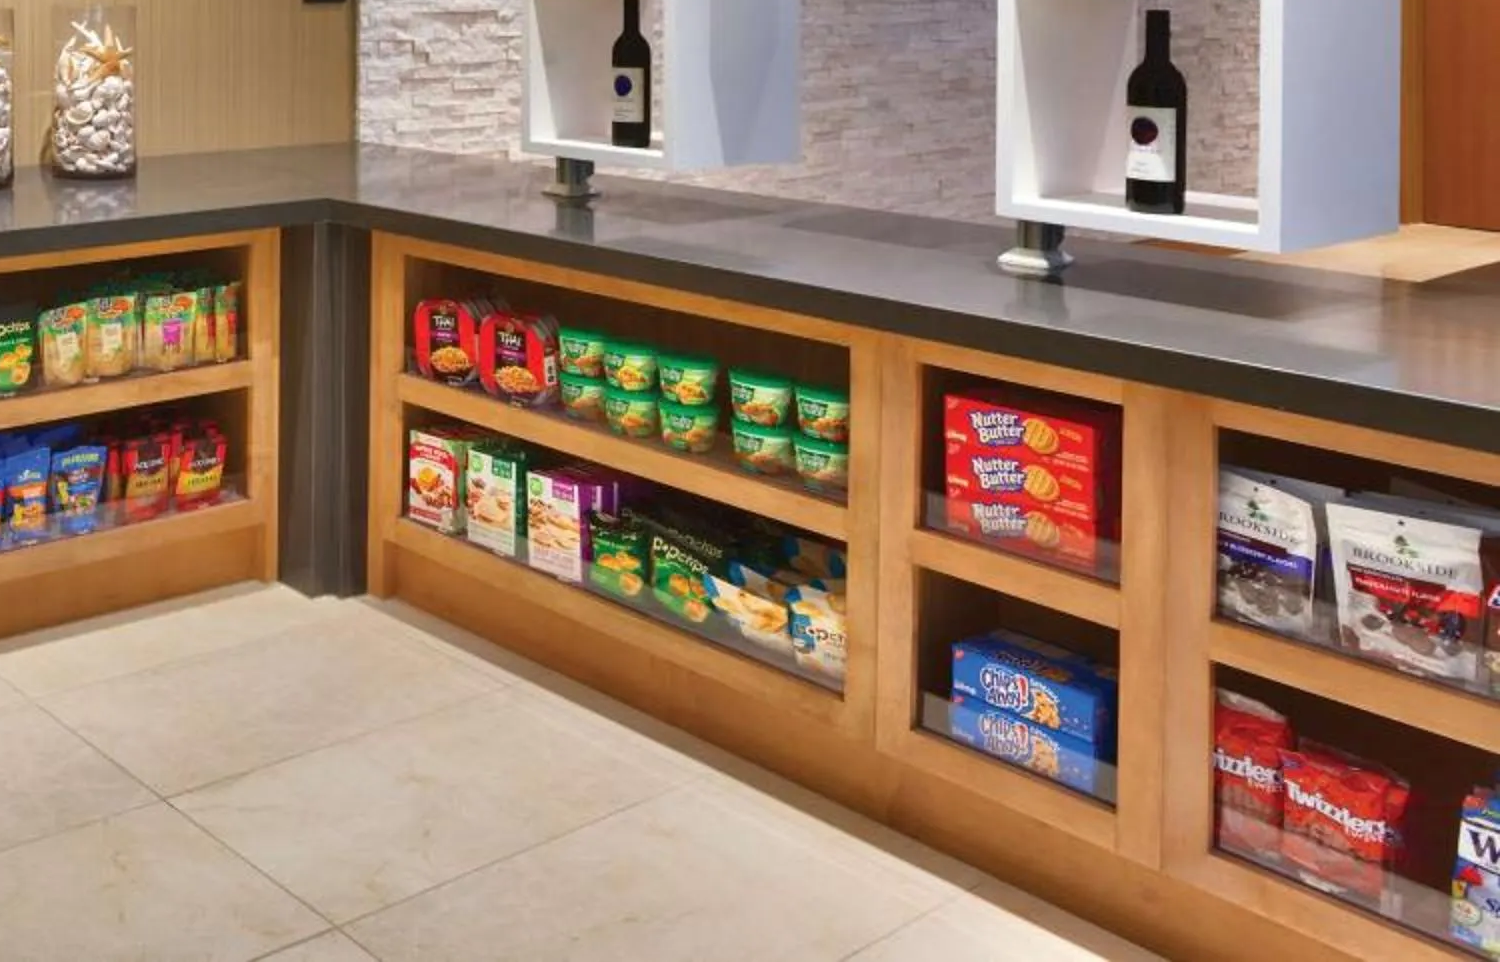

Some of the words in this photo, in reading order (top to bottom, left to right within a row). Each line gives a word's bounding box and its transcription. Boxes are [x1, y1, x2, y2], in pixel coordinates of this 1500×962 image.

[970, 411, 1020, 429] Nutter
[979, 425, 1026, 442] Butter
[972, 456, 1020, 475] Nutter
[979, 471, 1027, 489] Butter
[1353, 546, 1458, 579] BROOKSIDE
